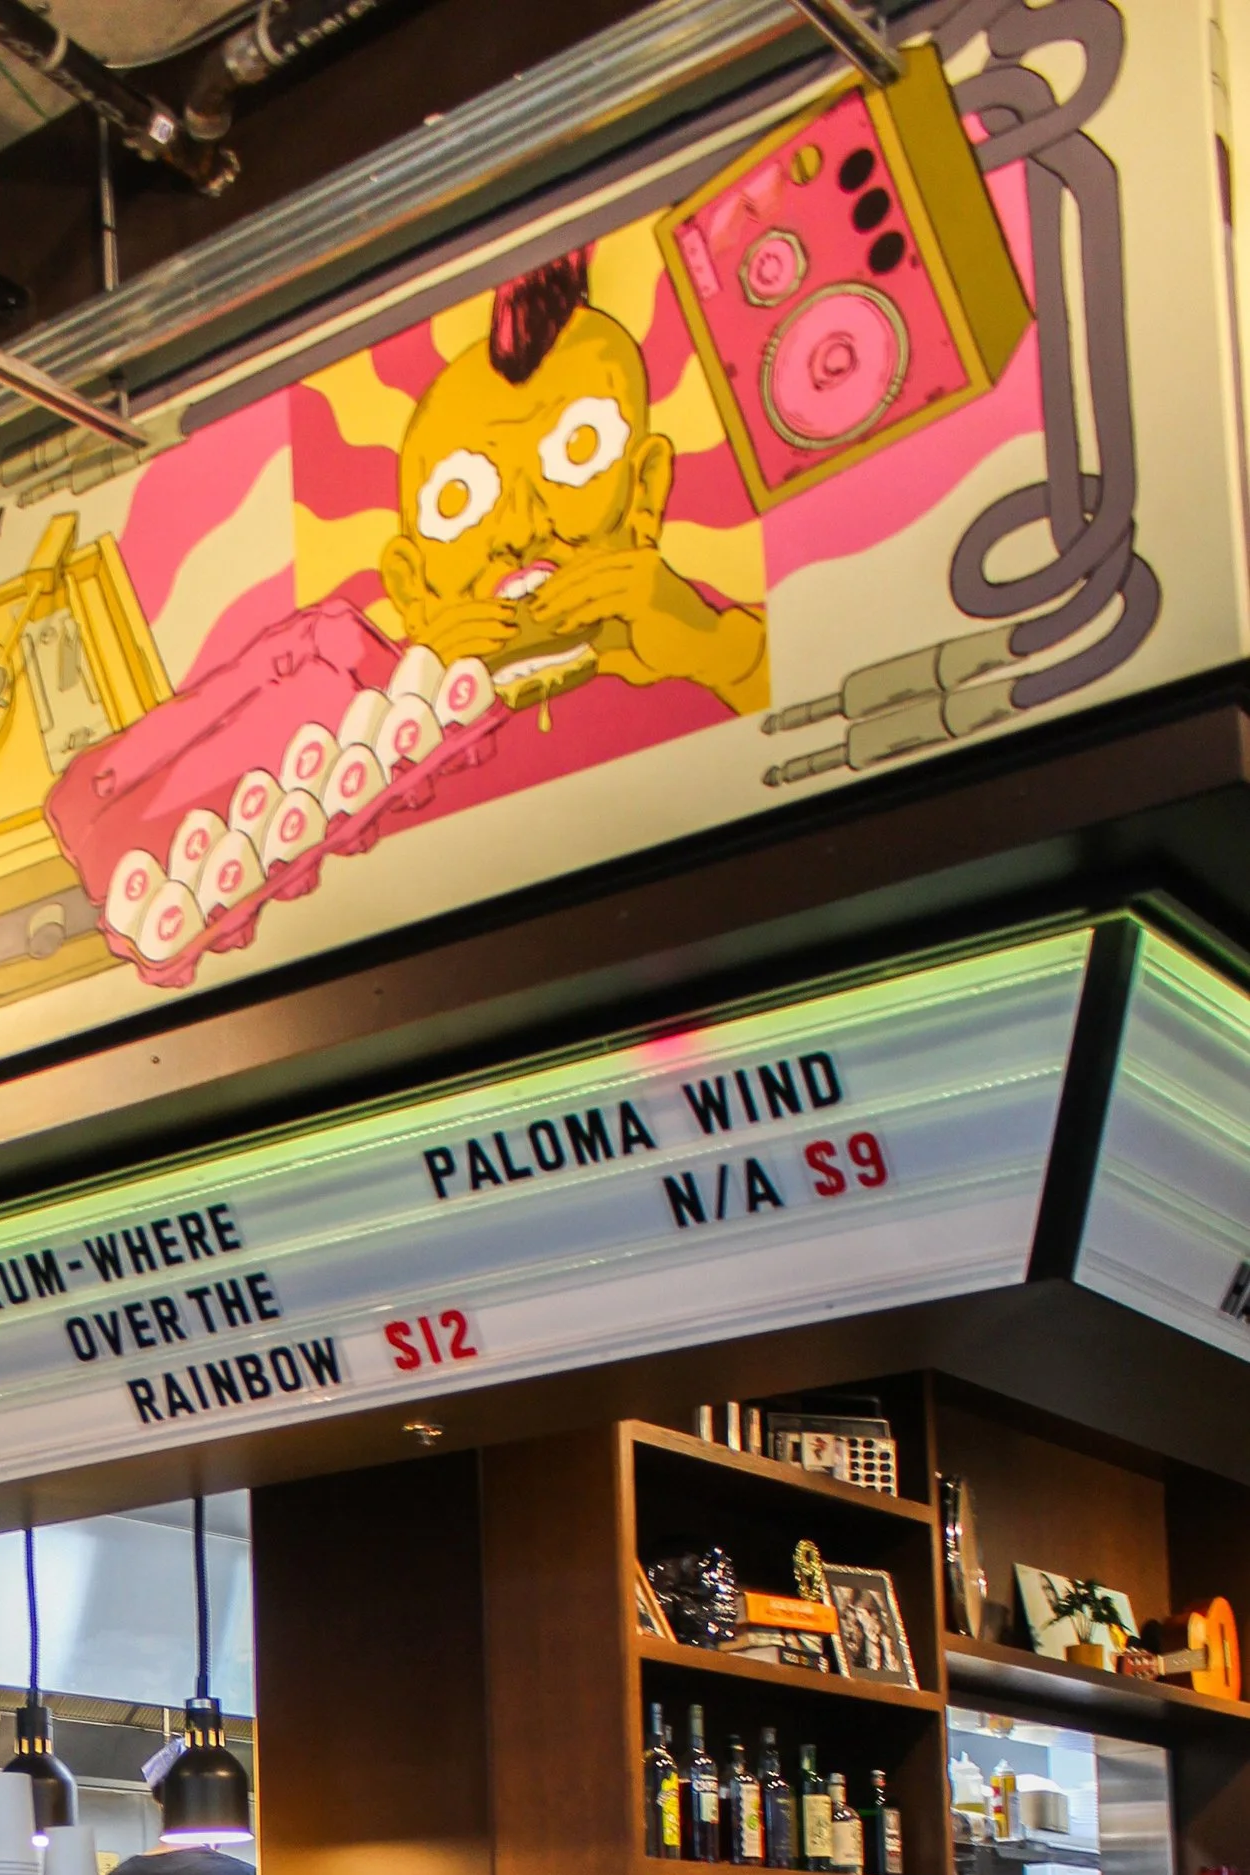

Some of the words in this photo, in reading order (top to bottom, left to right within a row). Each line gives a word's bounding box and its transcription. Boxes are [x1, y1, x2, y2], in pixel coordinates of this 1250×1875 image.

[423, 1100, 656, 1199] PALOMA
[682, 1052, 841, 1135] WIND
[663, 1158, 784, 1229] N/A
[66, 1297, 186, 1362] OVER
[186, 1272, 280, 1333] THE
[128, 1337, 341, 1423] RAINBOW
